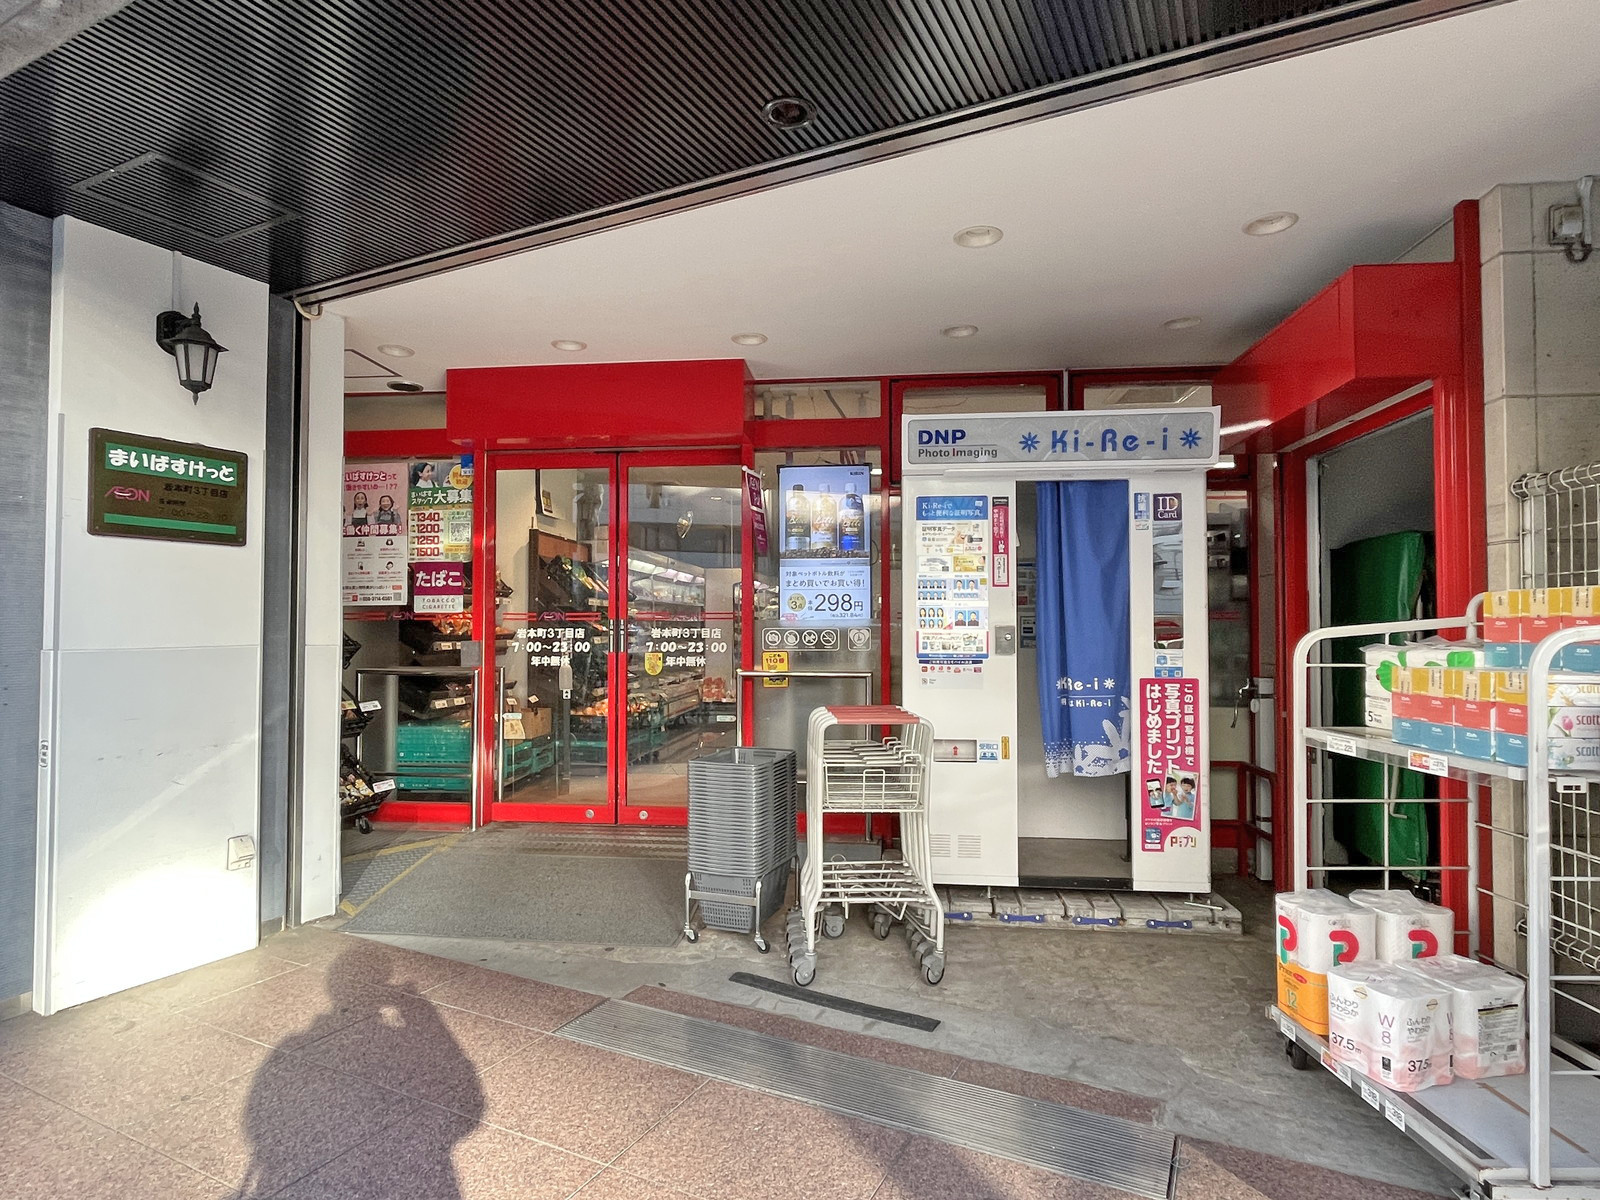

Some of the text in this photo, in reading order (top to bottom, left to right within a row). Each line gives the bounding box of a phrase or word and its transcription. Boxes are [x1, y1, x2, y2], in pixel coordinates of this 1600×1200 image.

[918, 429, 967, 445] DNP
[918, 447, 998, 459] Photo Imaging
[108, 448, 235, 482] まいばすけっと
[433, 489, 473, 504] 大募集
[1157, 496, 1179, 511] ID
[1157, 510, 1178, 519] Card
[415, 571, 462, 587] たばこ
[785, 579, 865, 588] まとめ買いでお買い得!
[516, 628, 585, 639] 岩本町3丁目店
[651, 628, 722, 639] 岩本町3丁目店
[530, 655, 571, 667] 年中無休
[665, 655, 707, 667] 年中無休
[1368, 710, 1374, 722] 5
[1145, 683, 1163, 775] はじめました
[1164, 683, 1182, 775] 写真プリント
[1183, 683, 1195, 766] この証明写真機で
[1378, 1012, 1395, 1028] W
[1381, 1030, 1392, 1045] 8
